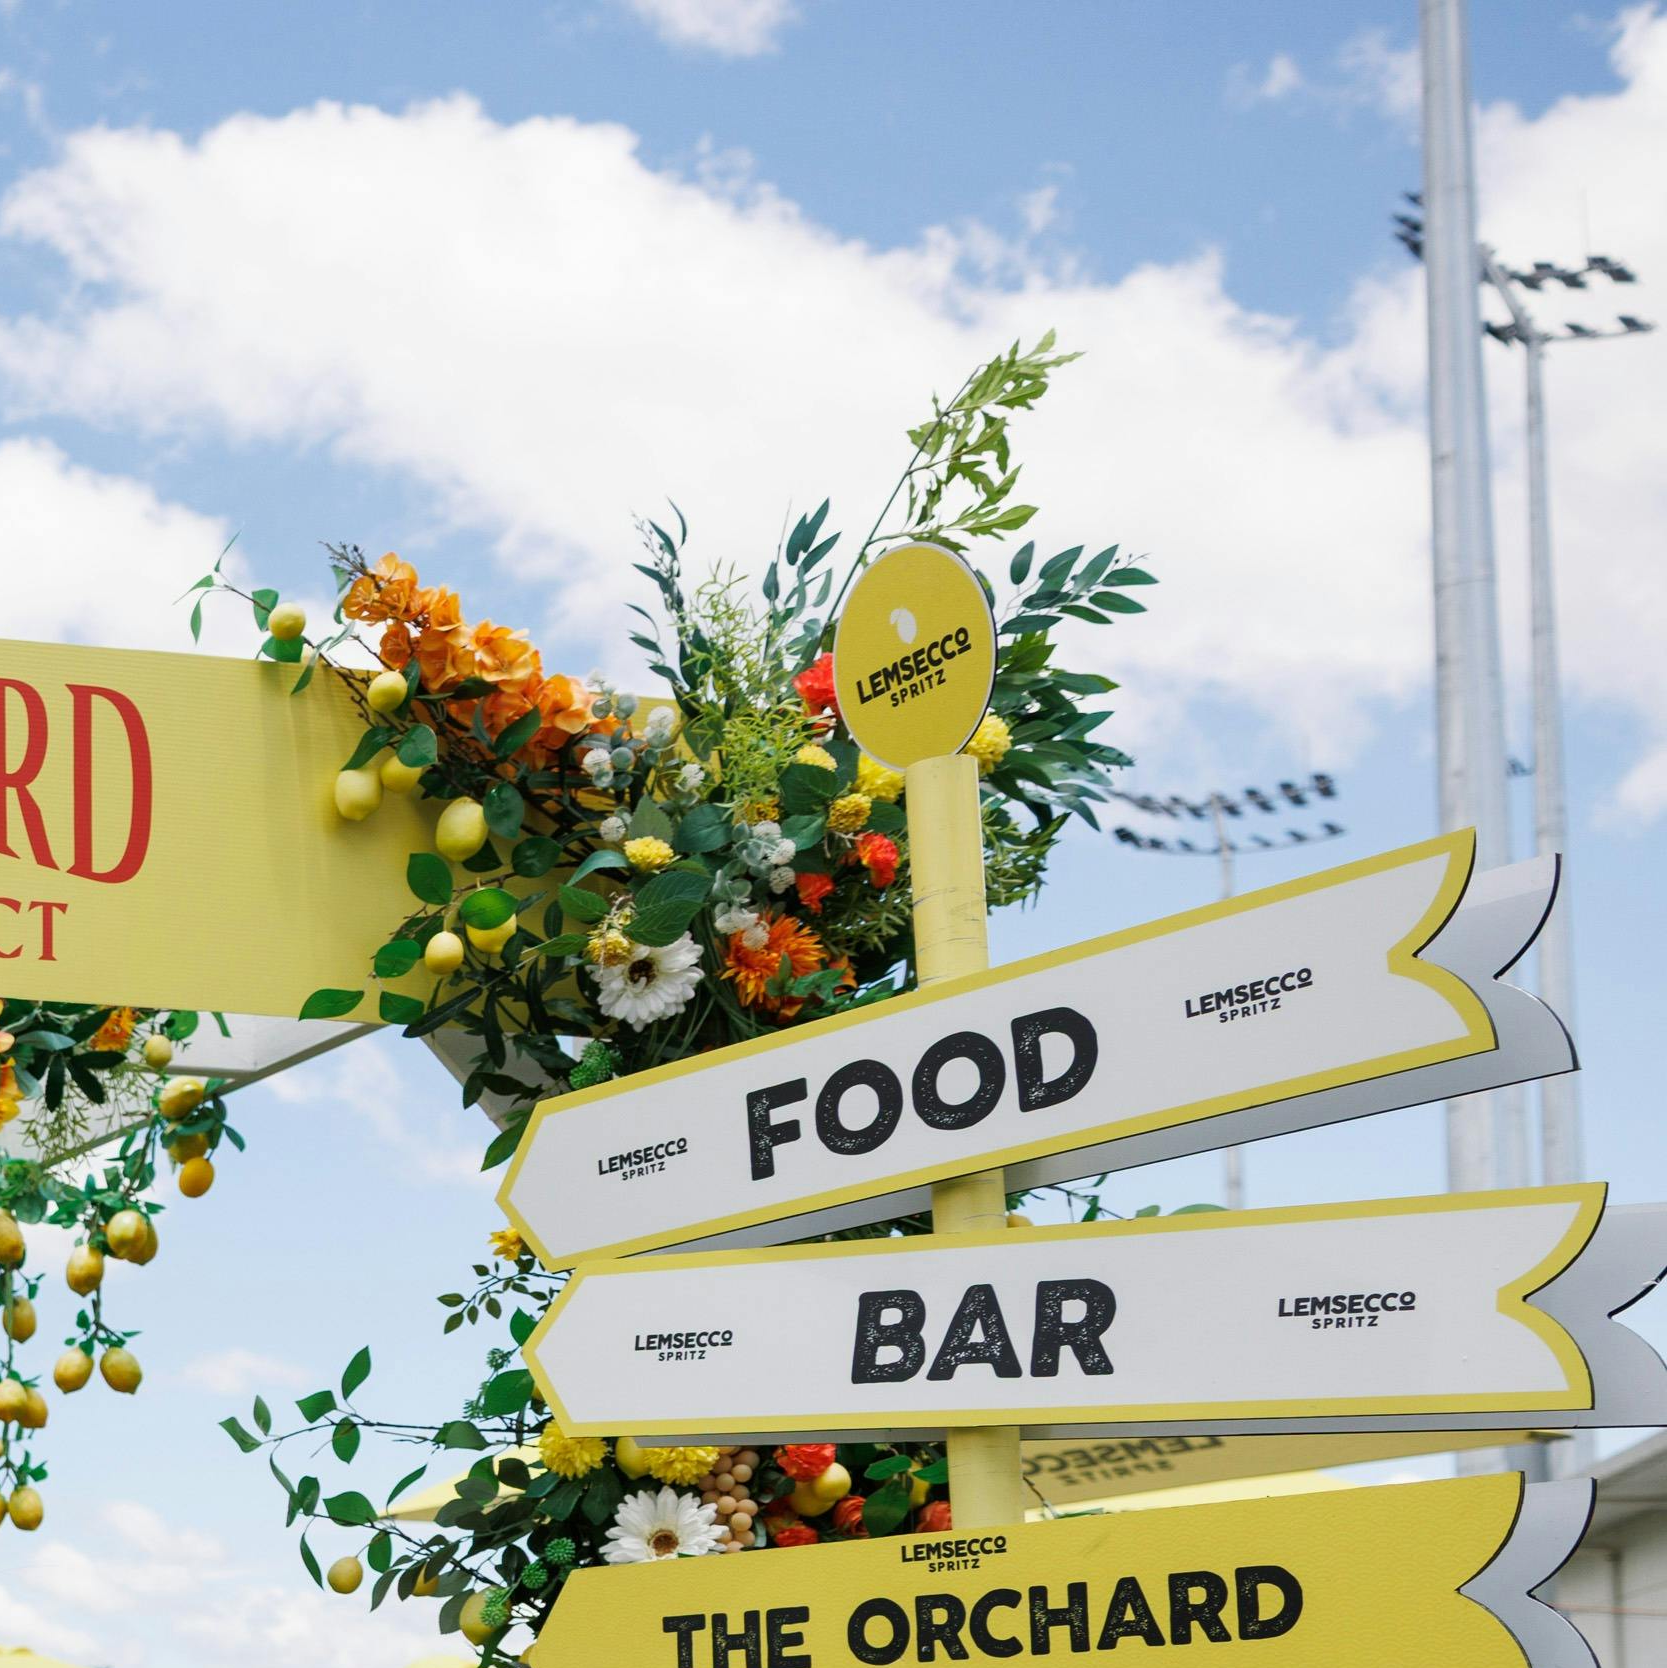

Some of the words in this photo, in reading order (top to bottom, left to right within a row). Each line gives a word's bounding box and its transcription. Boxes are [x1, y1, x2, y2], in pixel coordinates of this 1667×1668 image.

[890, 668, 947, 708] SPRITZ
[1219, 997, 1281, 1024] SPRITZ
[746, 1006, 1099, 1182] FOOD
[621, 1161, 666, 1181] SPRITZ
[851, 1278, 1117, 1385] BAR
[1312, 1315, 1379, 1330] SPRITZ
[658, 1350, 706, 1362] SPRITZ
[928, 1558, 980, 1573] SPRITZ
[847, 1565, 1304, 1666] ORCHARD
